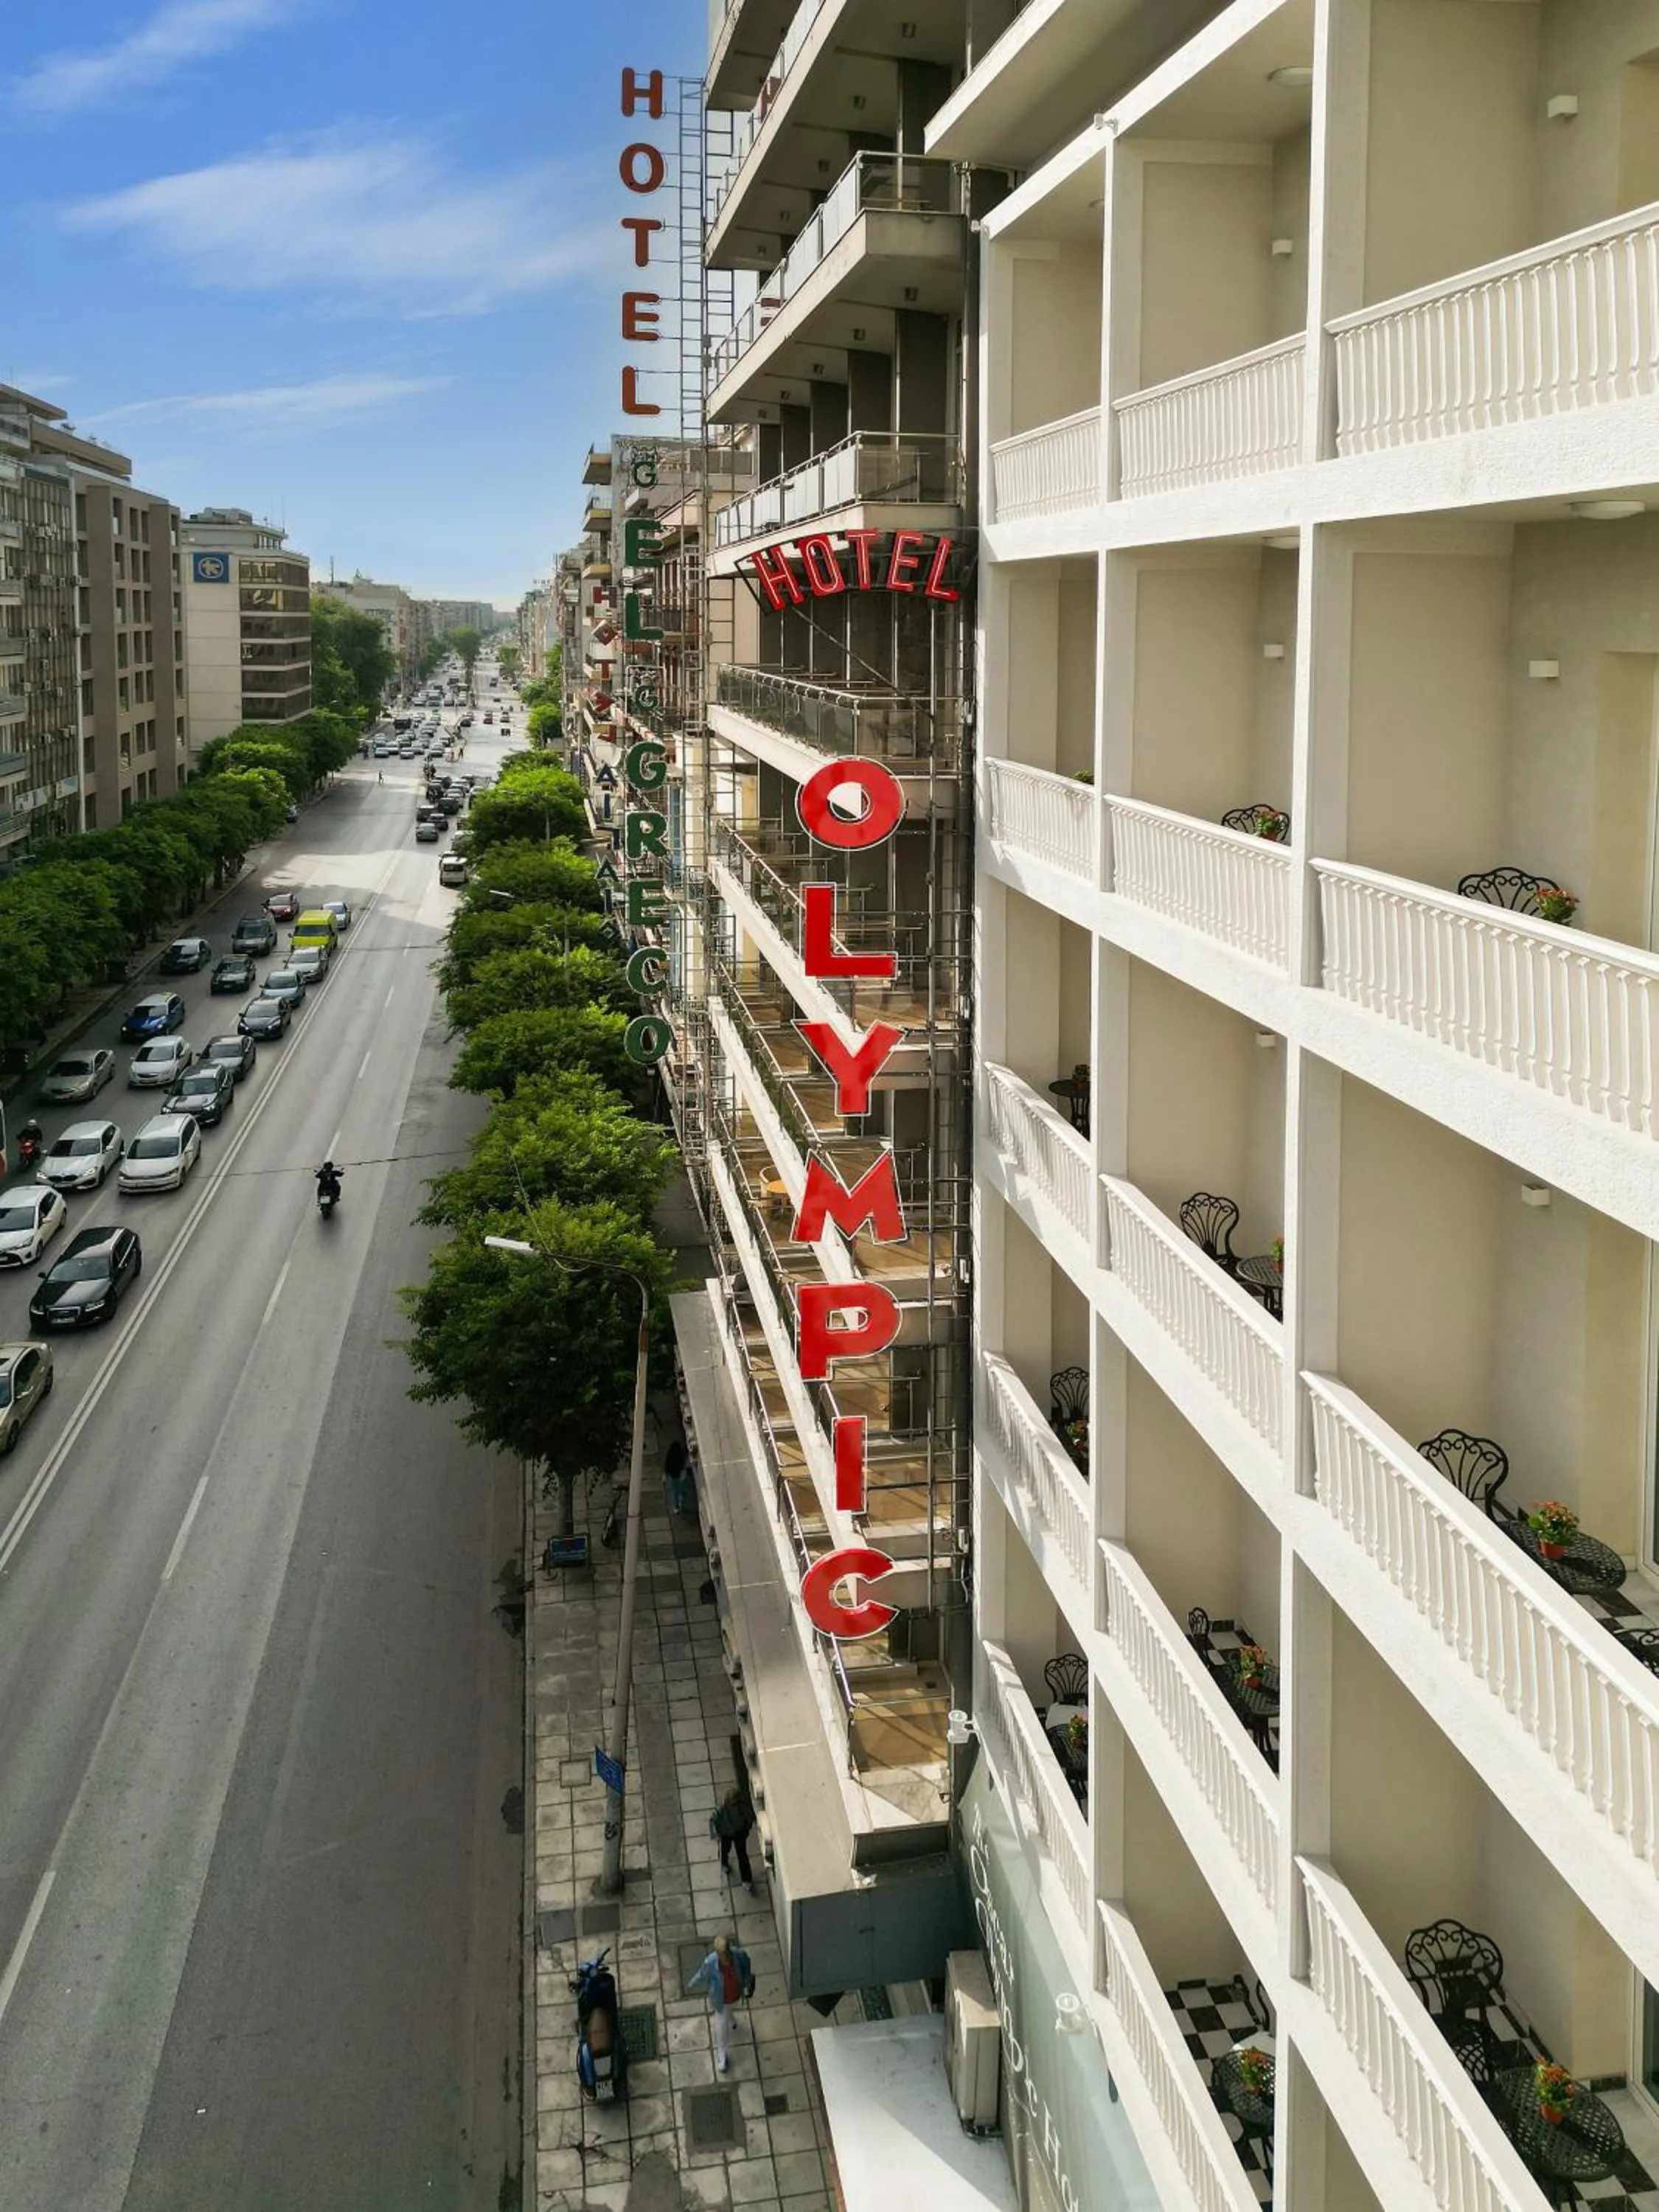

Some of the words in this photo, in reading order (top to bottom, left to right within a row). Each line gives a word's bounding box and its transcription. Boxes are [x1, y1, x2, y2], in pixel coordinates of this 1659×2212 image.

[619, 67, 665, 415] HOTEL
[625, 518, 664, 640] EL
[749, 528, 960, 611] HOTEL
[624, 740, 672, 1065] GRECO
[789, 757, 908, 1640] OLYMPIC
[1043, 2098, 1079, 2212] Ho
